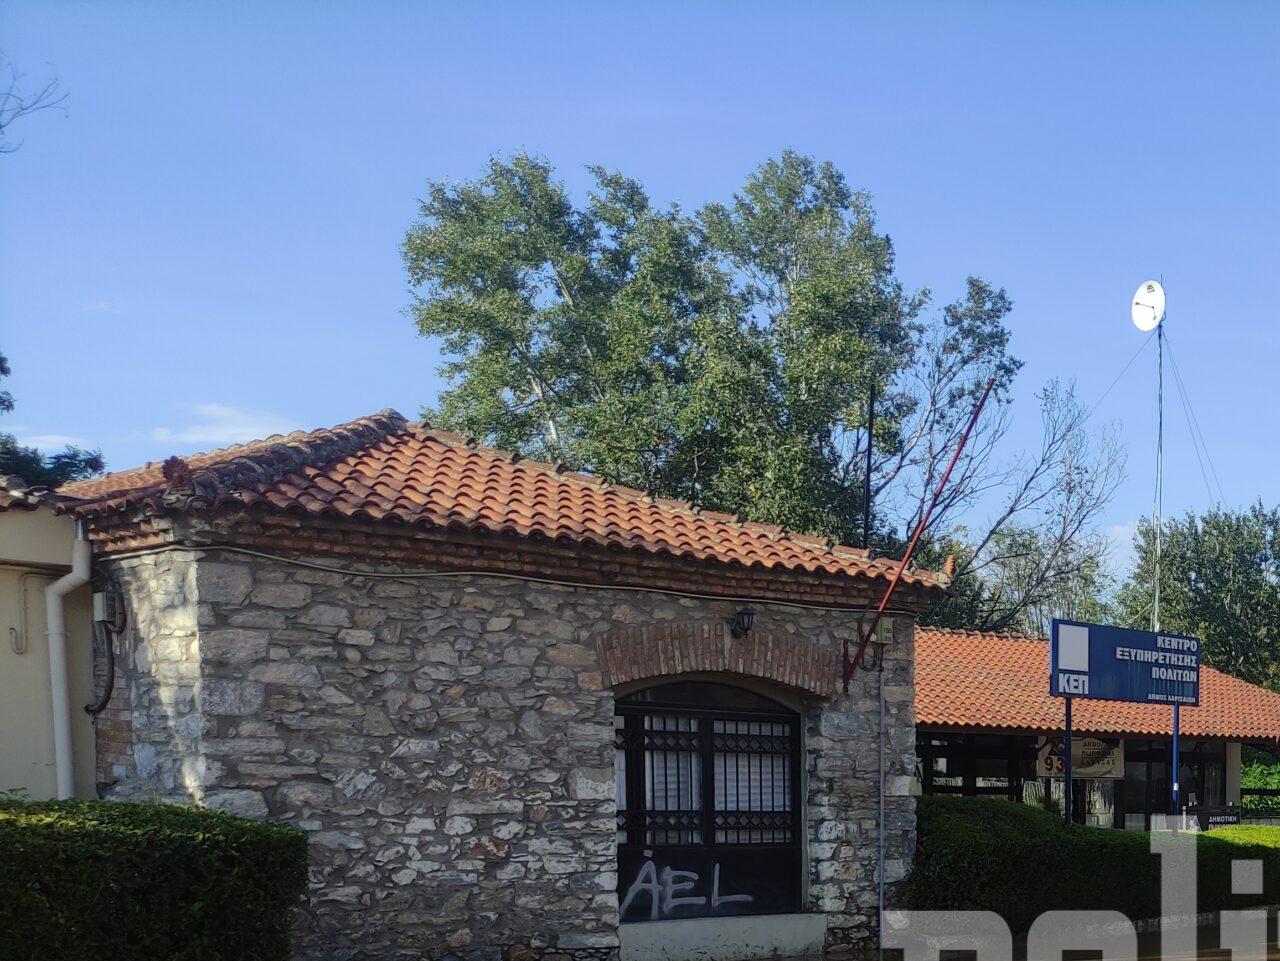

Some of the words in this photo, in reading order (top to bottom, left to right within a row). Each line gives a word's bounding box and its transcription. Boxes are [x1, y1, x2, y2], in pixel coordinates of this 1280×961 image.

[1157, 636, 1198, 652] ΚΕΝΤΡΟ
[1116, 647, 1197, 667] ΕΞΥΠΗΡΕΤΗΣΗΣ
[1151, 667, 1197, 682] ΠΟΛΙΤΩΝ
[1058, 673, 1089, 695] ΚΕΠ
